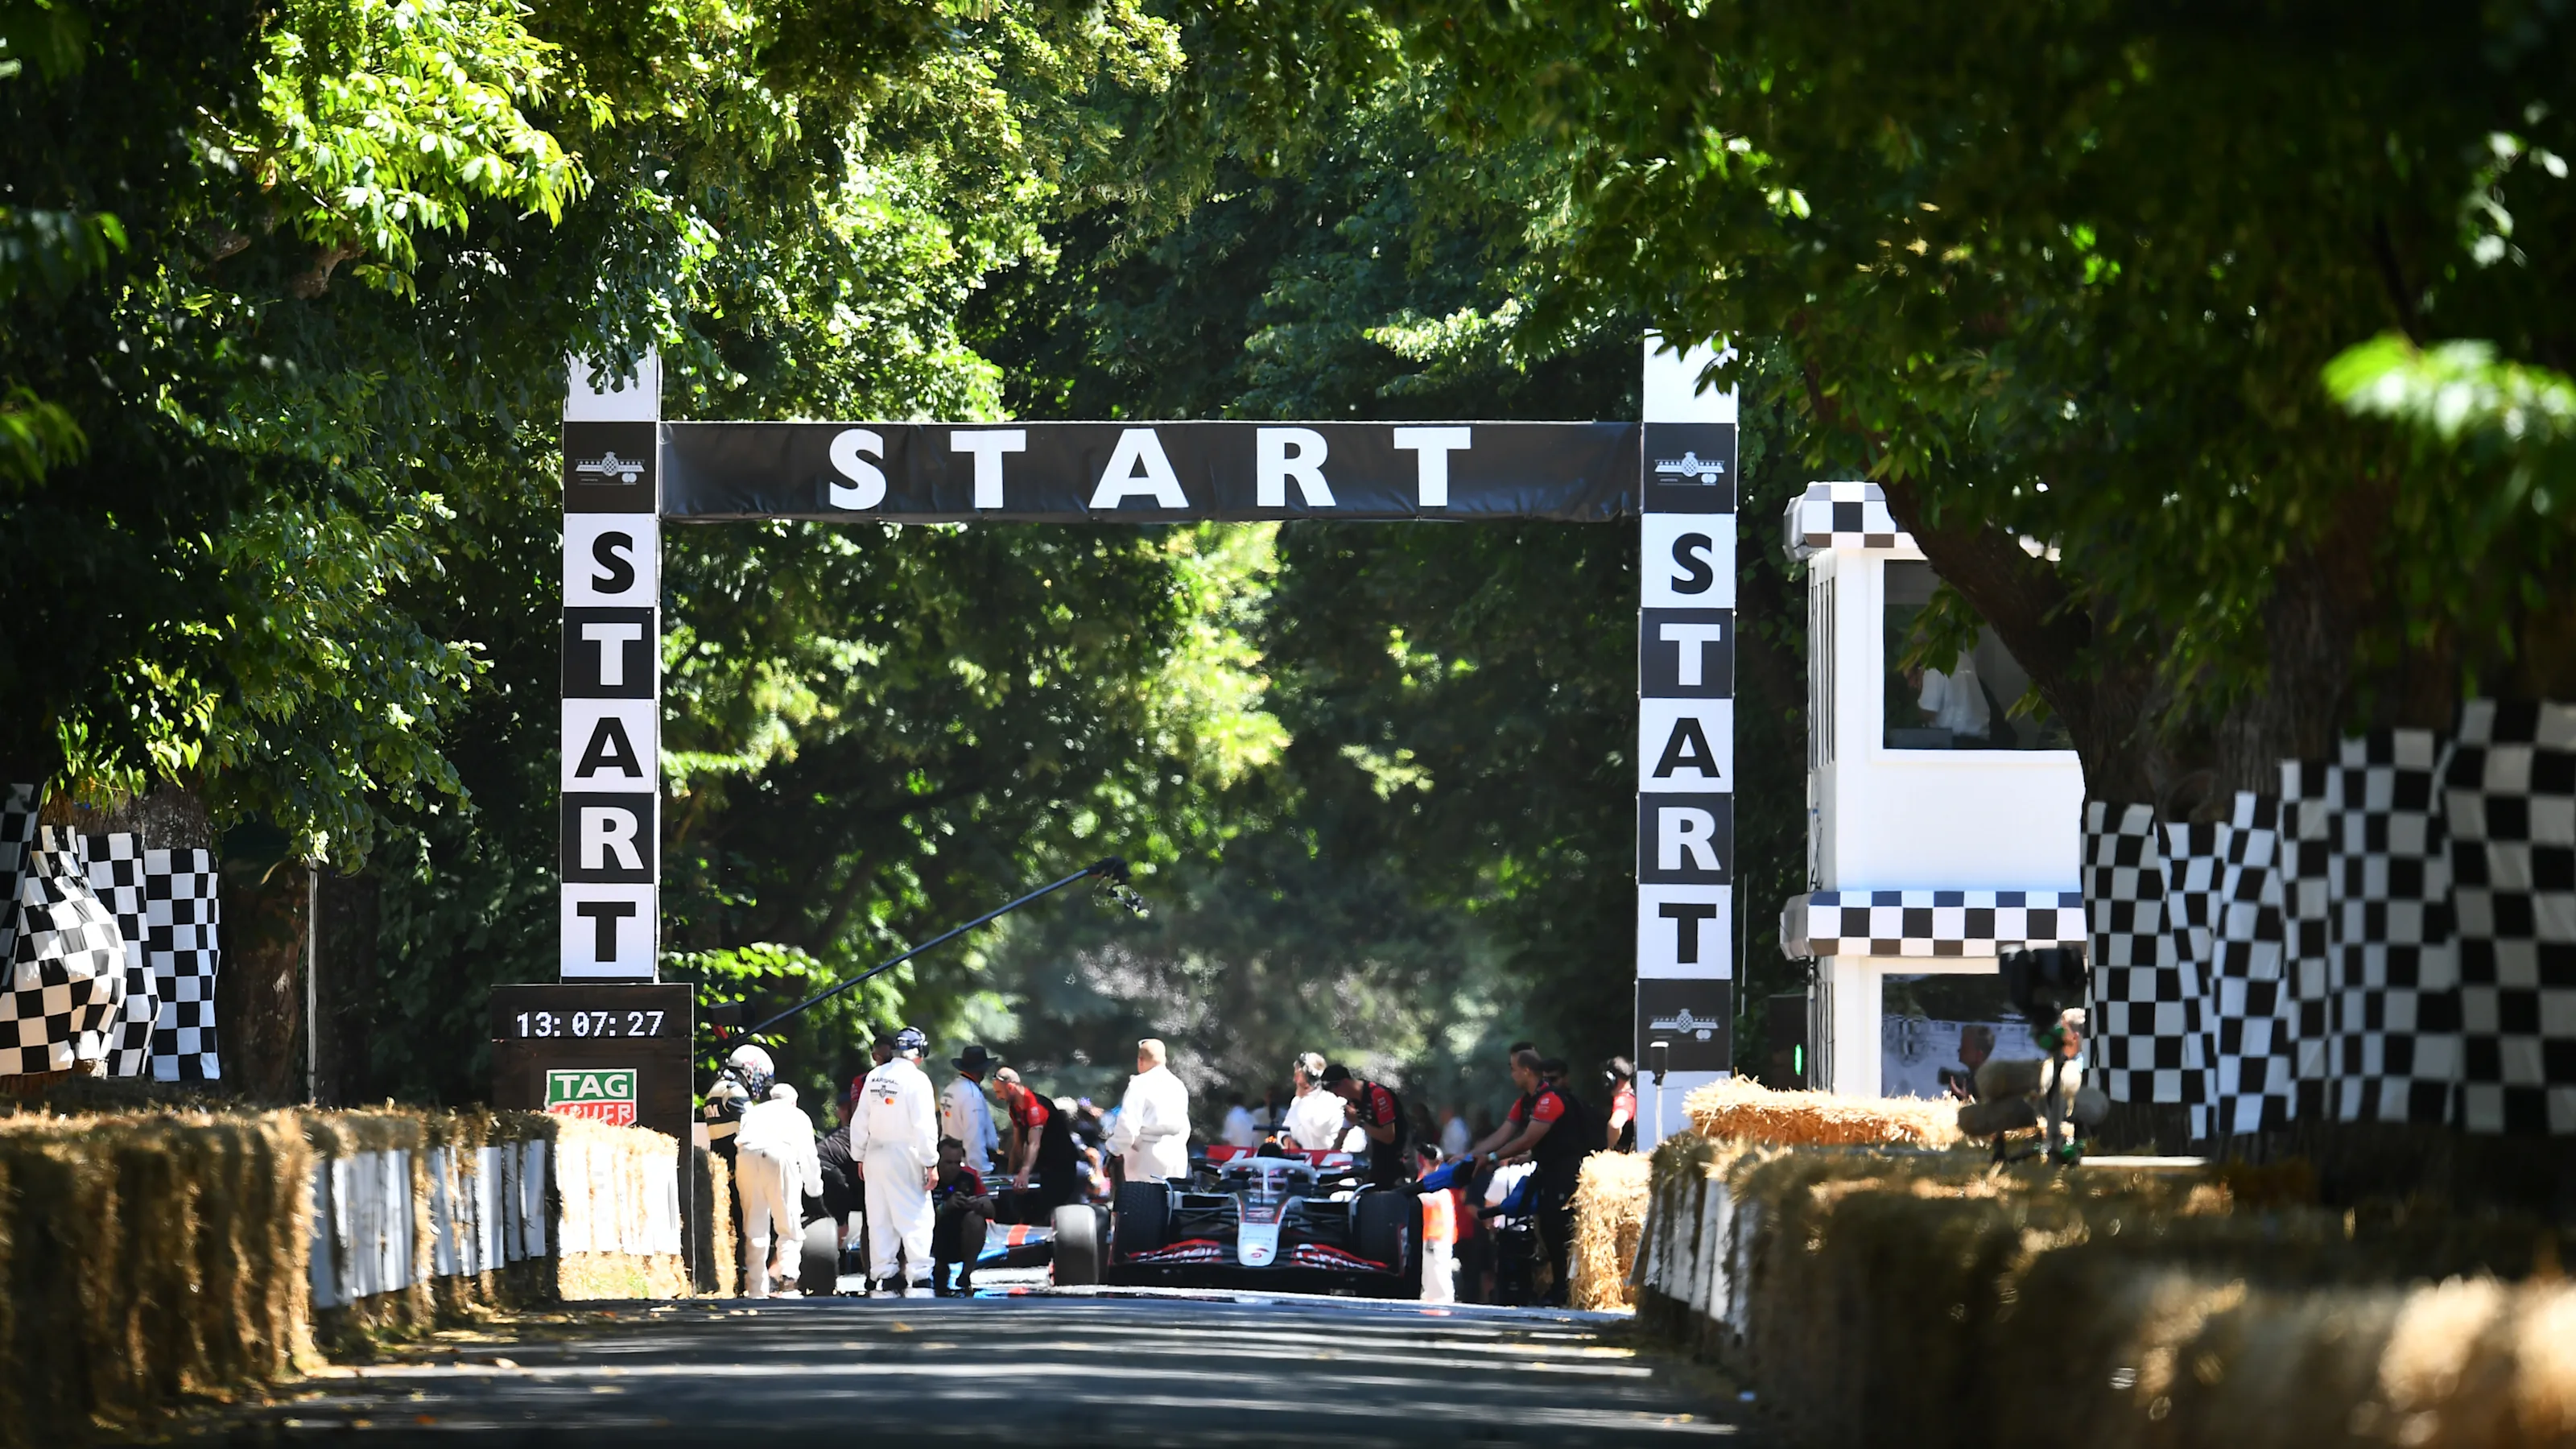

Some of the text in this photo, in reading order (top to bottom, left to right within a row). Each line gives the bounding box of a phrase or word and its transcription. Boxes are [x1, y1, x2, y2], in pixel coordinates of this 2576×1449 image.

[829, 427, 1472, 510] START
[575, 530, 643, 963] START
[1652, 532, 1721, 964] START
[554, 1074, 628, 1099] TAG
